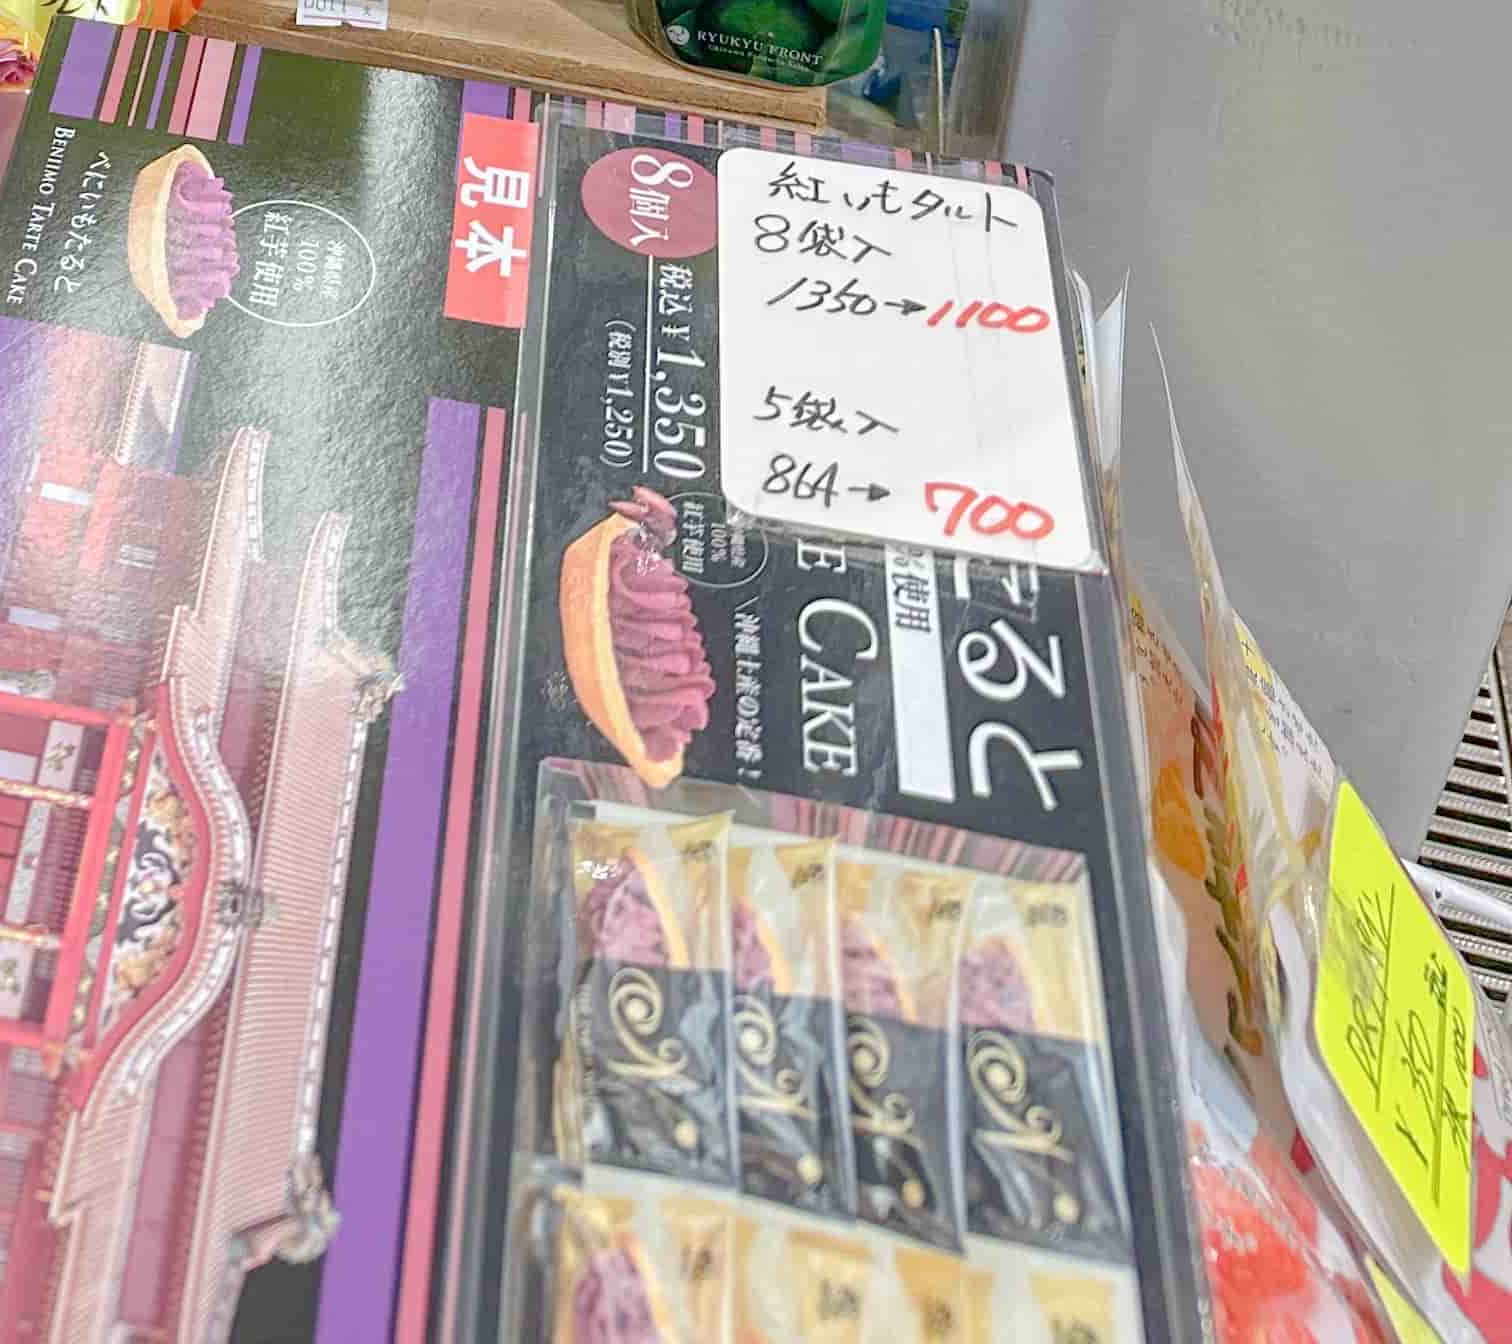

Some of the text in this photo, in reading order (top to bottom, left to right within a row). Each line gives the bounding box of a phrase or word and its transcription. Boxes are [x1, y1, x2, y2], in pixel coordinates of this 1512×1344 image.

[695, 28, 767, 53] RYUKYU
[4, 125, 76, 307] BENIIMO TARTE CAKE
[53, 150, 113, 296] べにいもたると
[455, 154, 531, 278] 見本
[627, 153, 696, 249] 8個入
[767, 162, 1020, 232] 紅いもタルト
[247, 210, 295, 308] 紅芋使用
[292, 239, 321, 293] 100%
[657, 262, 696, 316] 税込
[766, 279, 1051, 334] 1350 1100
[760, 452, 1055, 542] 864 700
[797, 595, 880, 779] CAKE
